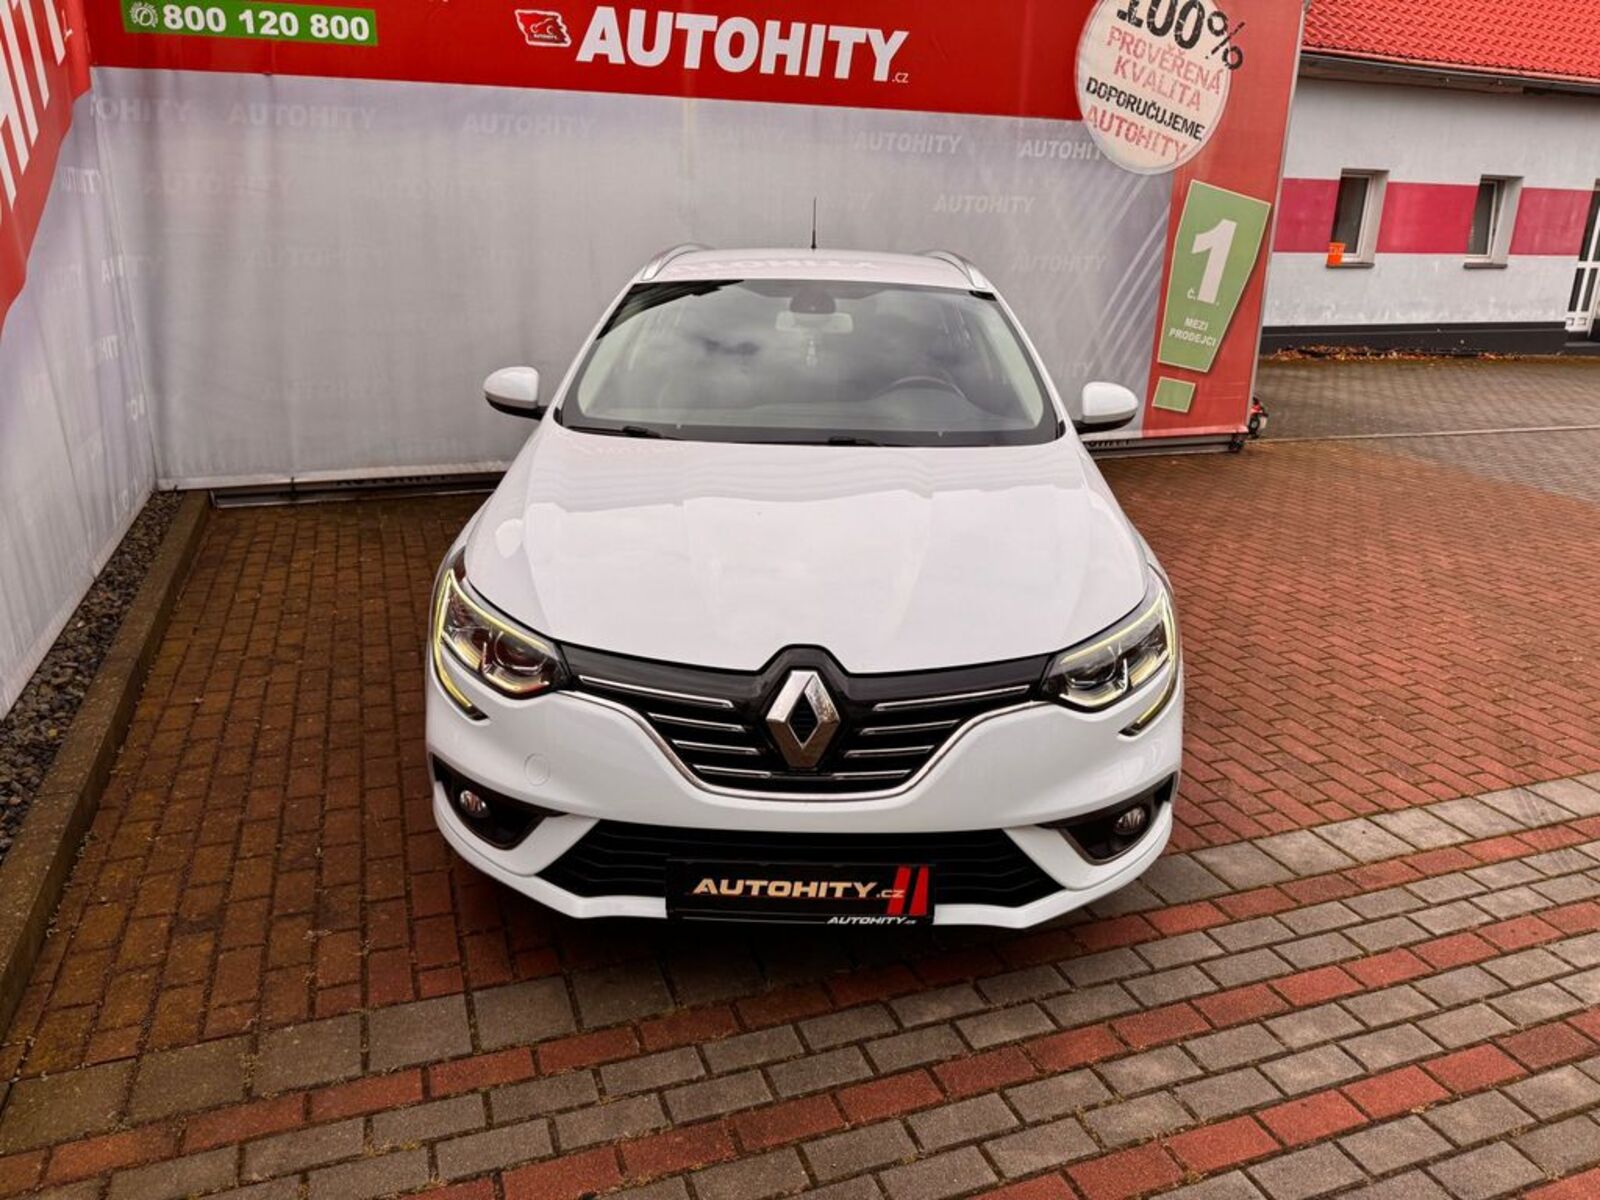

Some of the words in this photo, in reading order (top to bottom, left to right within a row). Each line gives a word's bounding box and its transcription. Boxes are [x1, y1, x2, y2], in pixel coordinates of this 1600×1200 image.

[162, 4, 227, 32] 800
[238, 9, 299, 36] 120
[310, 14, 370, 41] 800
[1106, 26, 1224, 95] PROVĚŘENÁ
[1114, 56, 1200, 112] KVALITA
[1086, 76, 1206, 142] DOPORUČUJEME
[853, 131, 963, 155] AUTOHITY
[1088, 106, 1188, 162] AUTOHITY
[932, 193, 1037, 214] AUTOHITY
[1168, 328, 1217, 348] PRODEJCI
[1184, 317, 1209, 332] MEZI
